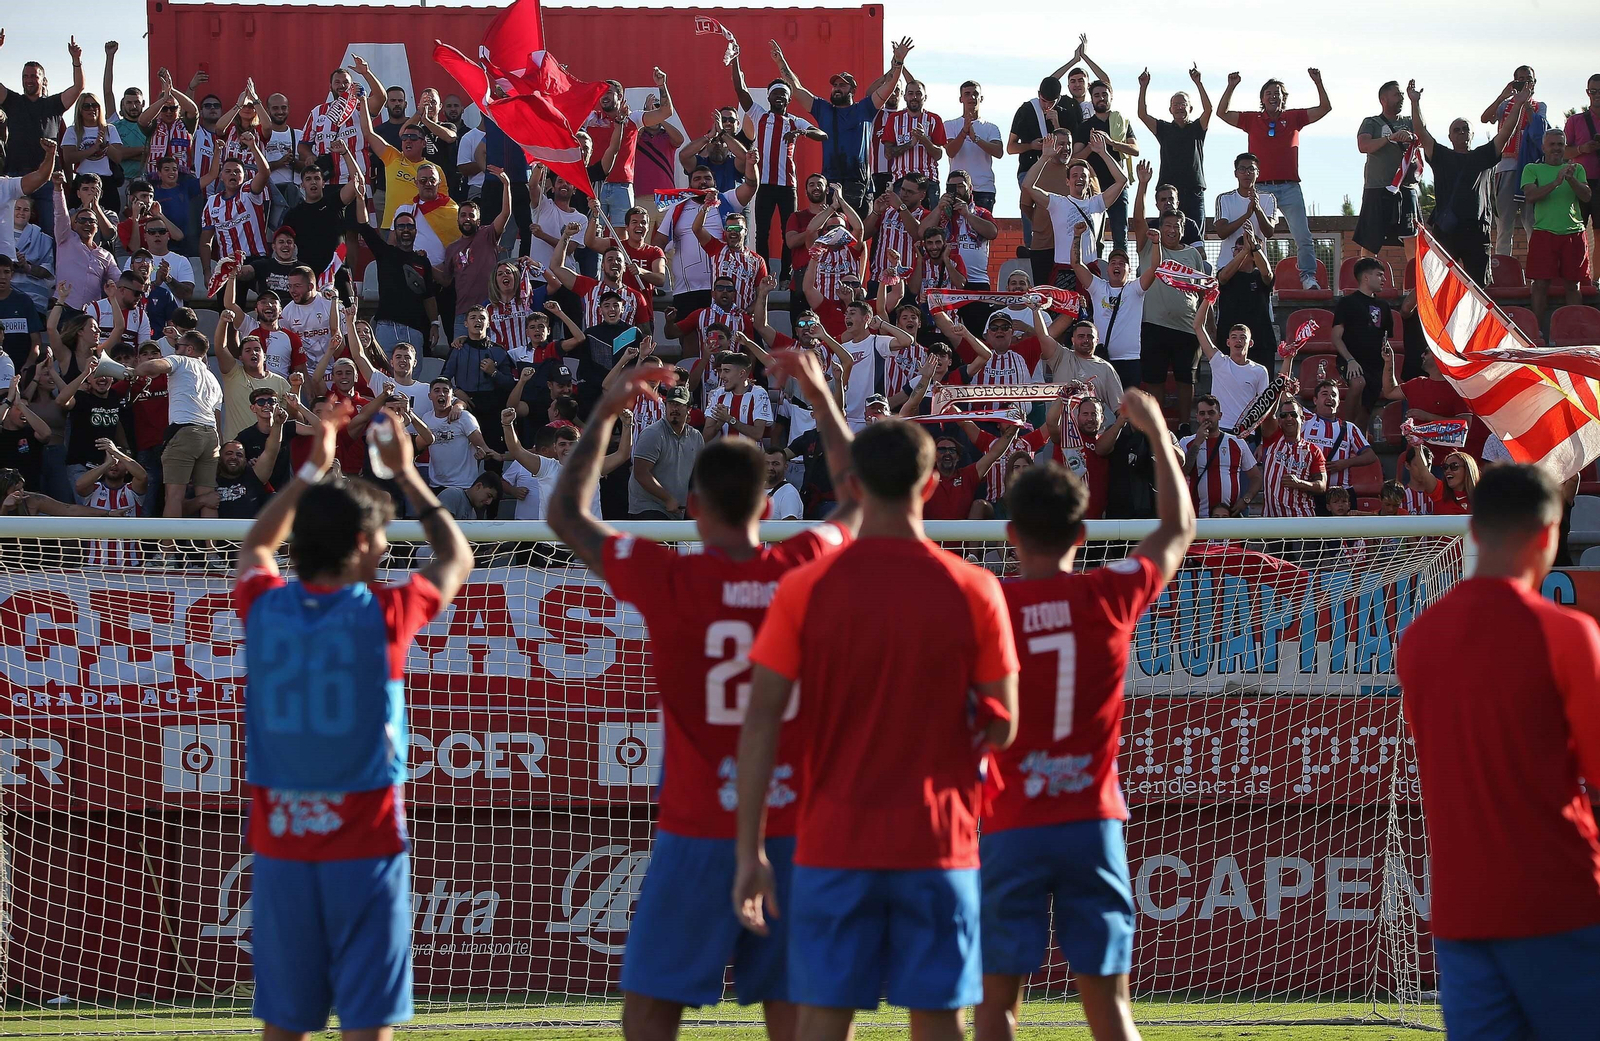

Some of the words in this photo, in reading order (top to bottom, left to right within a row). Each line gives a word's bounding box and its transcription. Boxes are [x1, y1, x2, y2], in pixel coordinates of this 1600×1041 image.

[955, 385, 1039, 398] ALGECIRAS
[1022, 601, 1072, 632] ZEQUI
[260, 626, 356, 737] 26
[1028, 632, 1076, 741] 7
[13, 692, 121, 707] GRADA
[142, 686, 203, 704] ACF
[1124, 776, 1270, 794] tendencias
[461, 940, 530, 958] transporte
